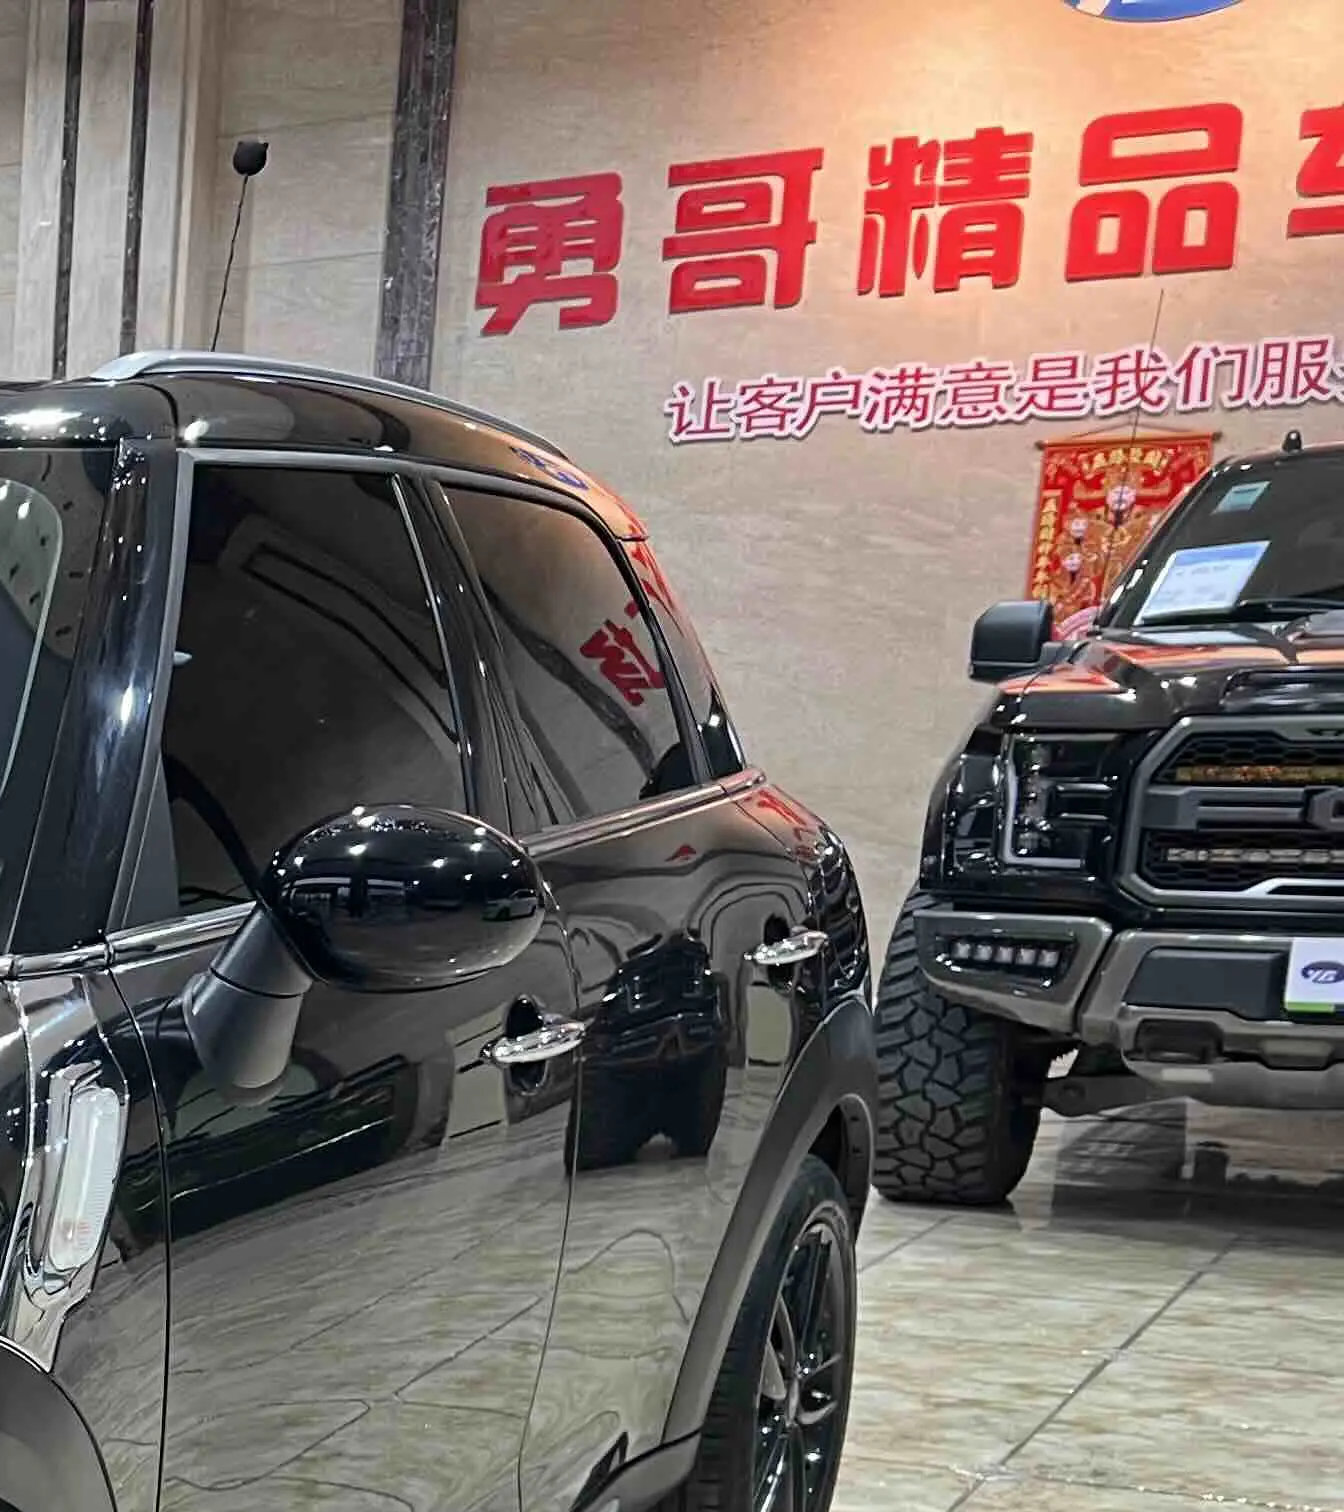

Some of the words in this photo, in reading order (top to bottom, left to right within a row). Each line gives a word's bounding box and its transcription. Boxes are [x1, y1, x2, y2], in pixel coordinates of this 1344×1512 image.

[667, 335, 1344, 438] 让客户满意是我们服
